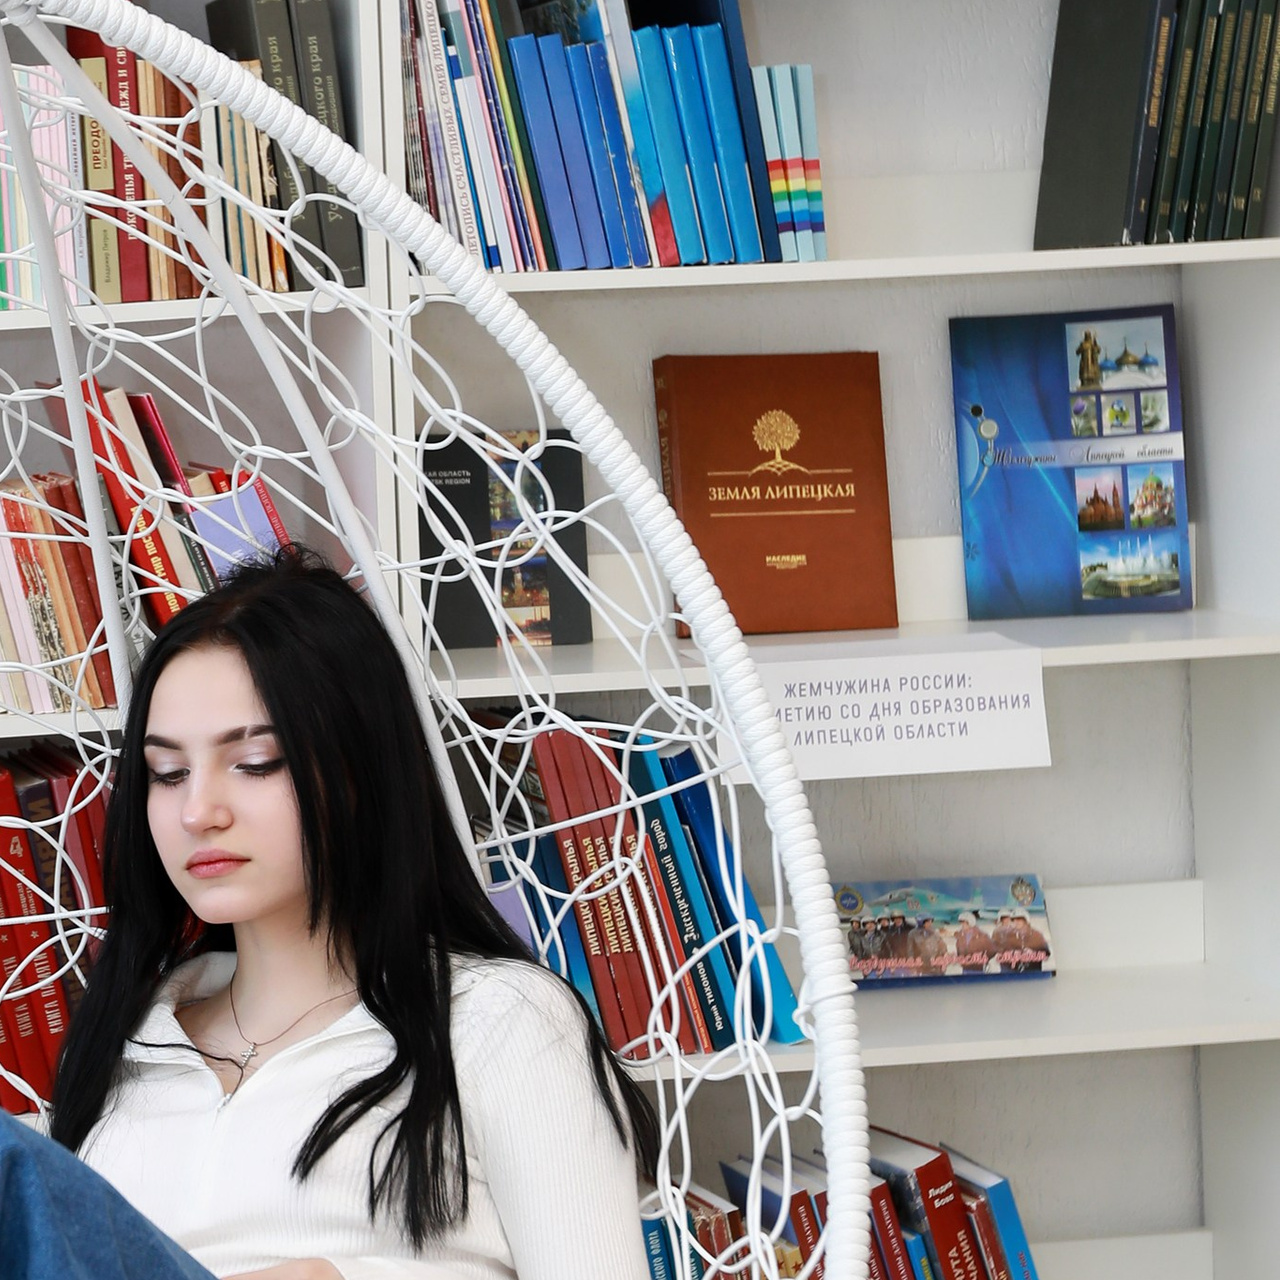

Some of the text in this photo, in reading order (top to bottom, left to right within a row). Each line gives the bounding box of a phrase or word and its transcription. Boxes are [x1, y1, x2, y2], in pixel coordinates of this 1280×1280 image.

[266, 37, 282, 73] края
[306, 37, 321, 73] края
[434, 63, 452, 105] СЕМЕЙ
[444, 107, 469, 190] СЧАСТЛИВЫХ
[459, 191, 480, 256] ЛЕТОПИСЬ
[101, 229, 112, 284] Владимир Петров
[708, 483, 856, 502] ЗЕМЛЯ ЛИПЕЦКАЯ
[152, 555, 167, 577] МИР
[784, 673, 974, 699] ЖЕМЧУЖИНА РОССИИ:
[840, 693, 1032, 721] СО ДНЯ ОБРАЗОВАНИЯ
[793, 721, 970, 746] ЛИПЕЦКОЙ ОБЛАСТИ
[651, 818, 670, 851] город
[663, 854, 700, 944] Засекреченный
[695, 961, 715, 1003] ТИХОНОВ
[43, 999, 64, 1035] КНИГА
[710, 1004, 725, 1031] Юрий
[927, 1180, 953, 1199] Лидия
[799, 1205, 815, 1243] МАТЕРЕЙ
[879, 1198, 897, 1238] МАТЕРЕЙ
[647, 1230, 662, 1255] ФЛОТА
[889, 1237, 903, 1256] ДЛЯ
